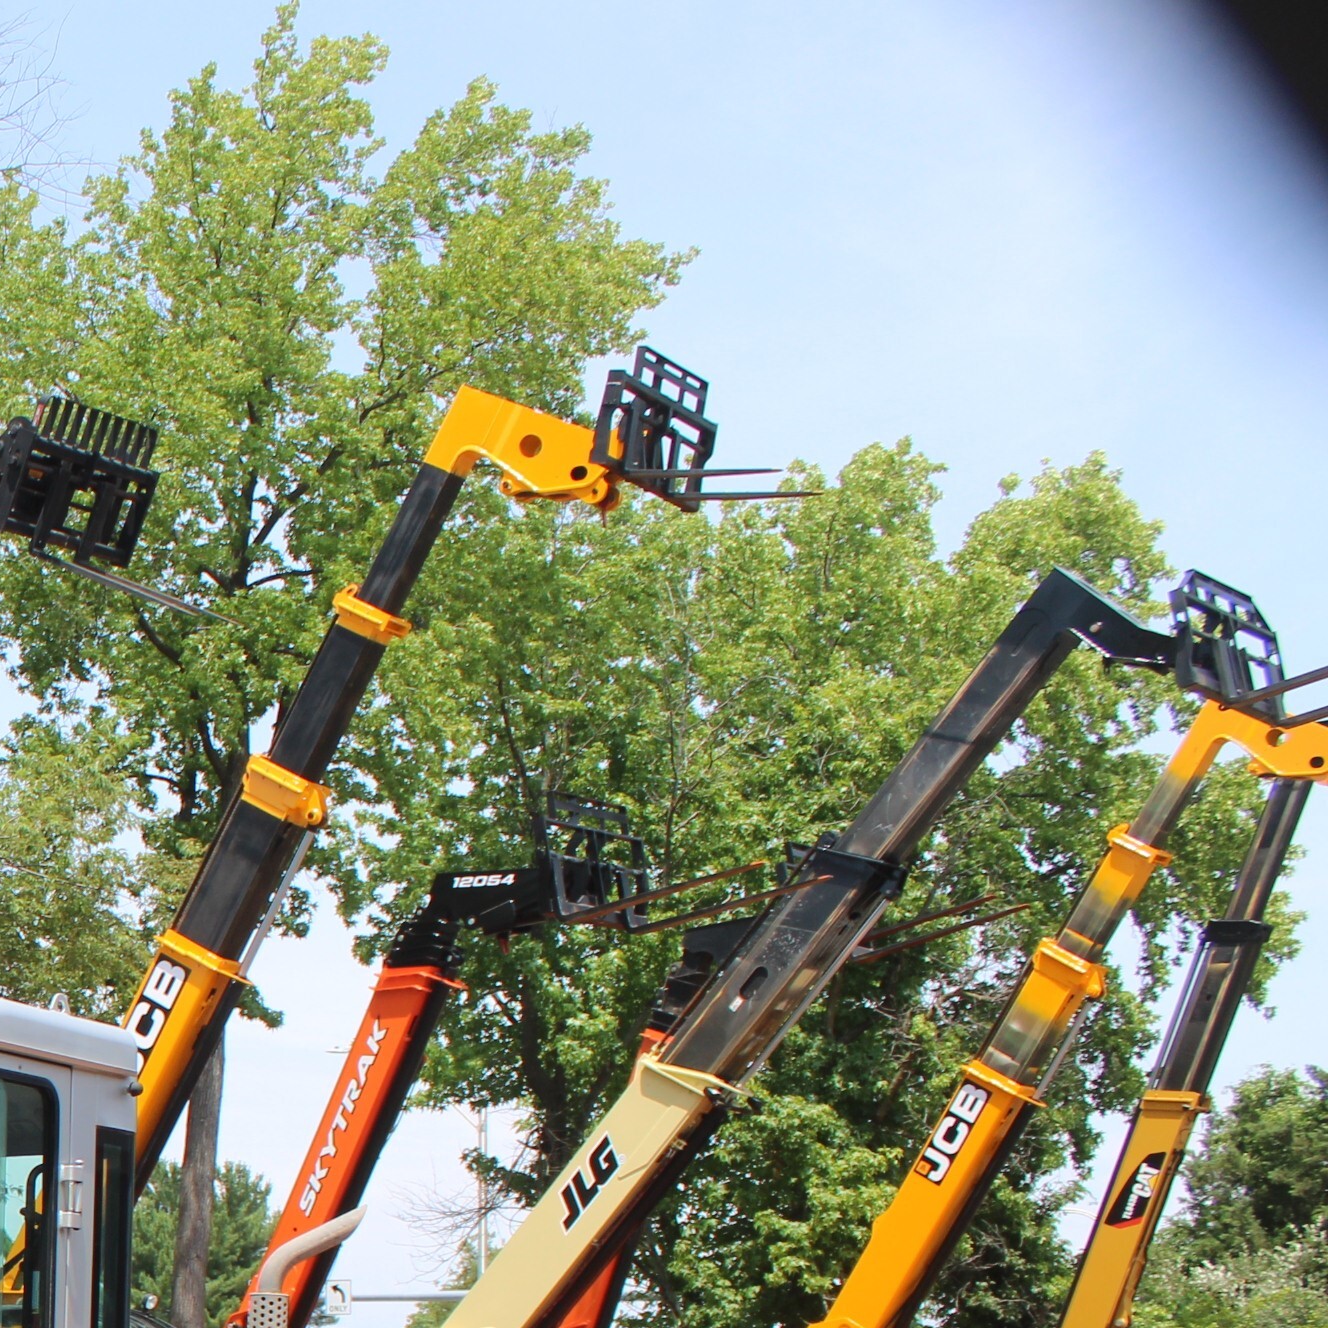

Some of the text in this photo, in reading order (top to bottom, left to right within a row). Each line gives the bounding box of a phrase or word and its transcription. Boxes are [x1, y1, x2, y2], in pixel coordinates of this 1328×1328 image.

[452, 873, 515, 889] 12054
[125, 959, 186, 1076] CB
[299, 1016, 389, 1218] SKYTRAK
[924, 1083, 988, 1182] JCB
[559, 1132, 621, 1234] JLG
[1131, 1162, 1161, 1198] CAT
